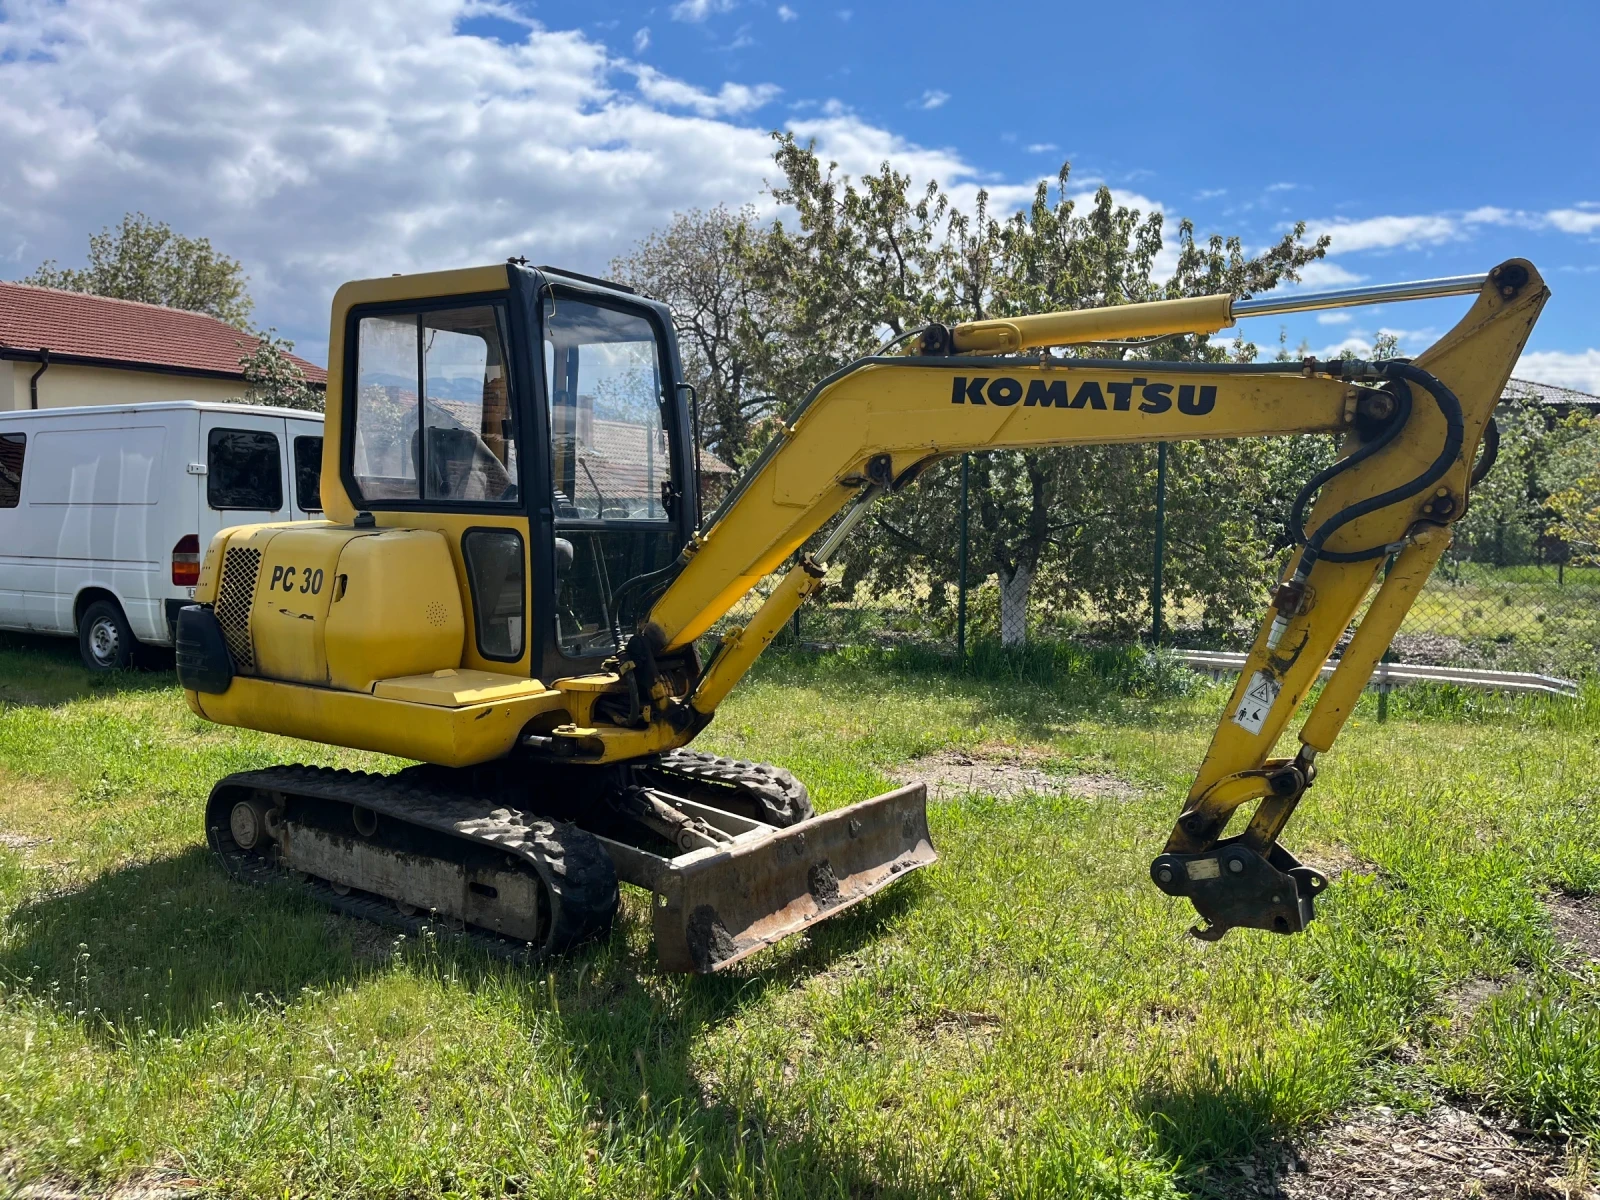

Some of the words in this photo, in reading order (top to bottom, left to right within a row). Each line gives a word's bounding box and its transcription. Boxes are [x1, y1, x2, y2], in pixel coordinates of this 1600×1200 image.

[952, 377, 1218, 415] KOMATSU
[270, 566, 296, 592] PC
[300, 567, 324, 595] 30
